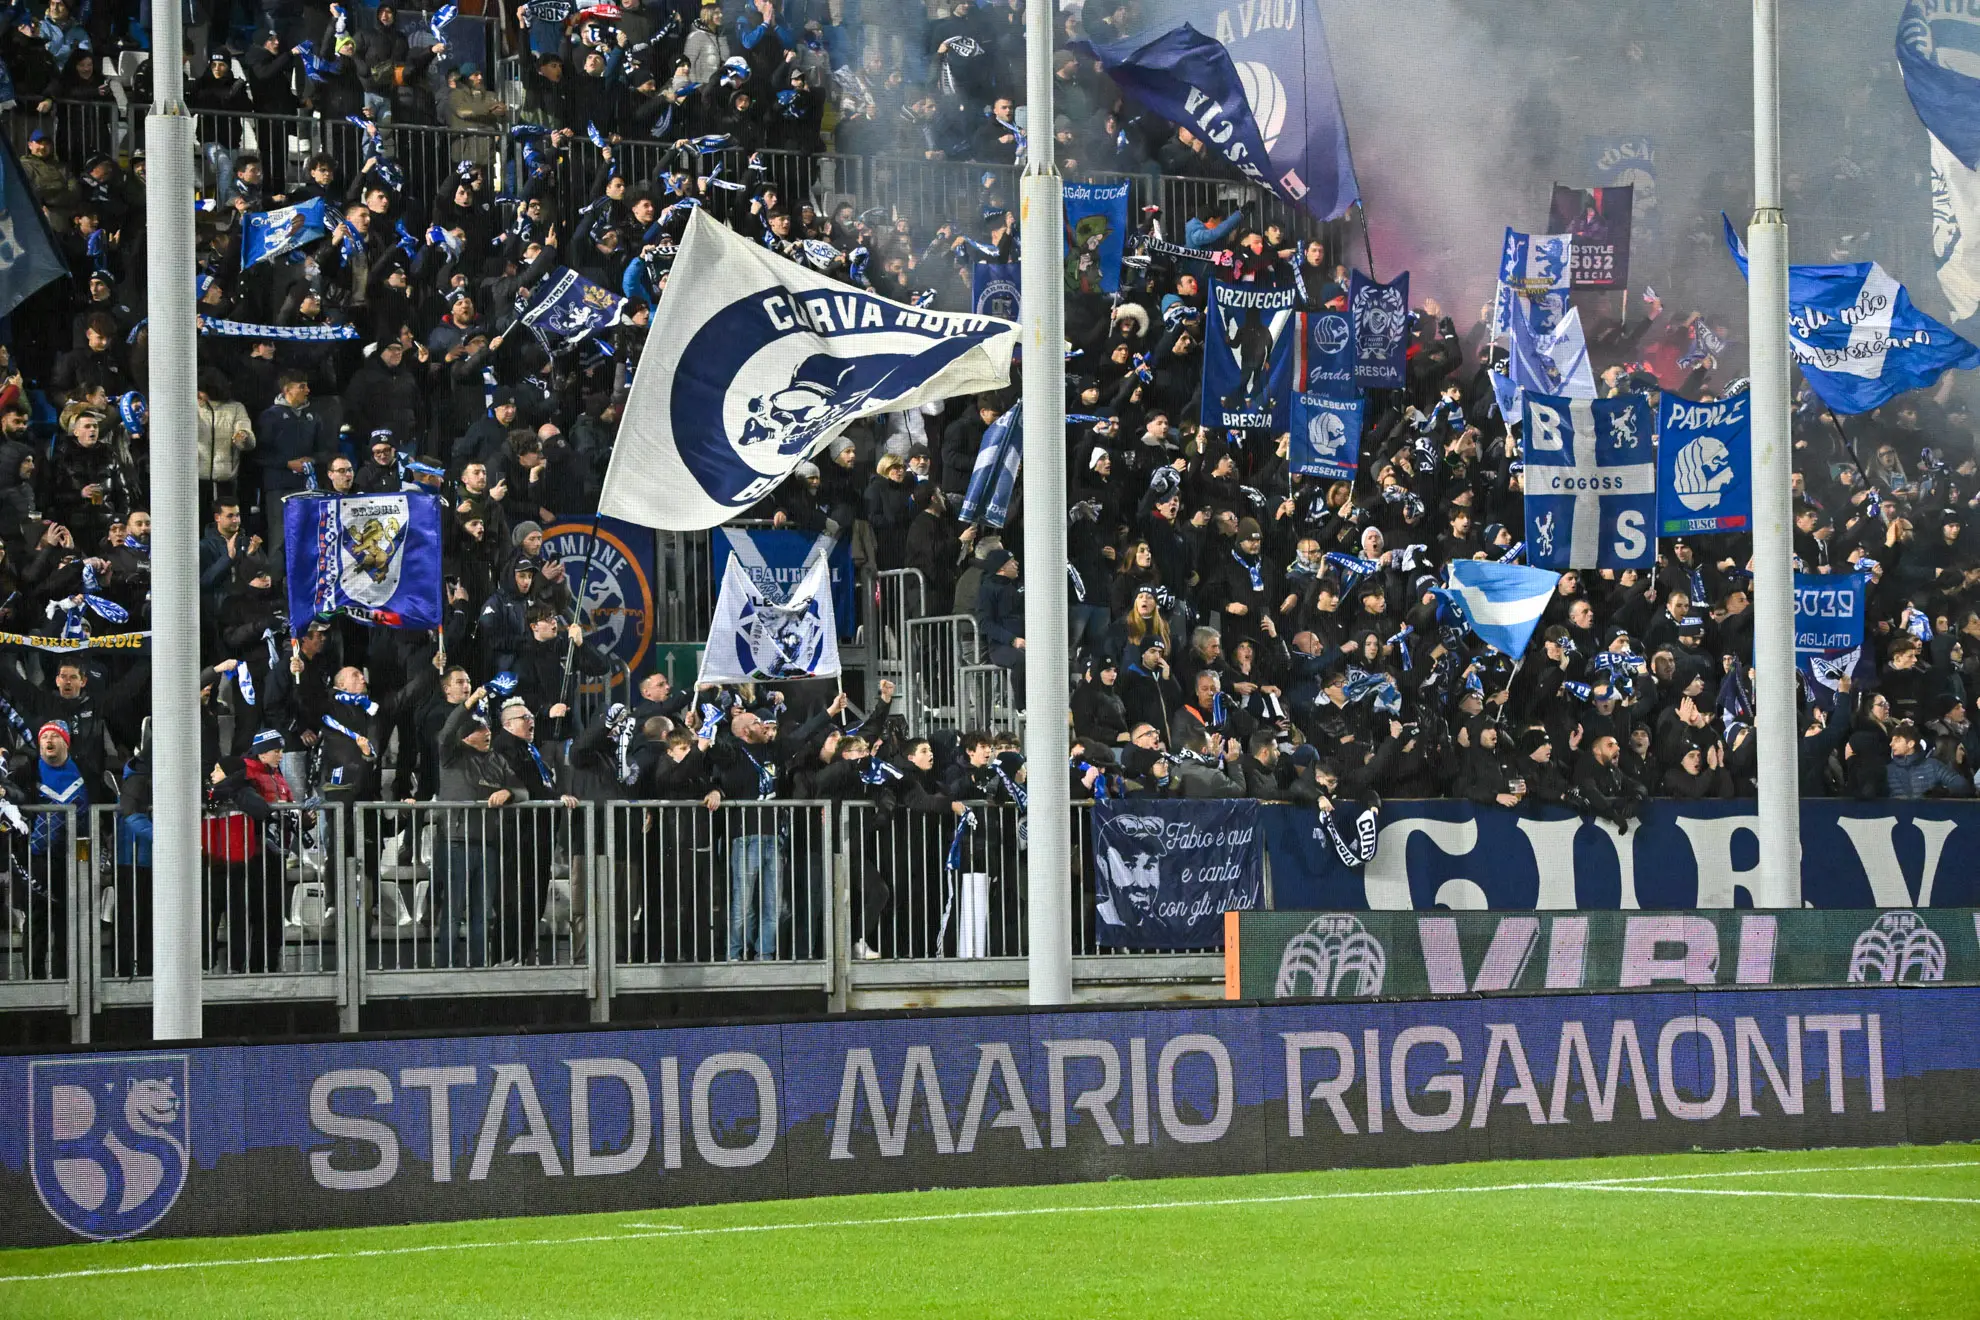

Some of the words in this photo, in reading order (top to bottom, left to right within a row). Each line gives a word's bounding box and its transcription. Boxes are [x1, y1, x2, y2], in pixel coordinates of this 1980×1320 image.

[1184, 86, 1282, 200] ESCIA
[1063, 185, 1091, 200] IGADA
[1581, 246, 1614, 254] STYLE
[1571, 272, 1613, 280] ESCIA
[1214, 286, 1295, 309] ORZIVECCHI
[1840, 291, 1887, 325] mio
[763, 295, 884, 336] CURVA
[1310, 365, 1352, 383] Garda
[1354, 364, 1398, 378] BRESCIA
[1300, 396, 1357, 412] COLLEBEATO
[1222, 412, 1273, 428] BRESCIA
[1529, 401, 1564, 451] B
[1300, 464, 1348, 479] PRESENTE
[1613, 510, 1647, 561] S
[544, 534, 628, 577] RMIONE
[88, 633, 143, 649] MEDIE
[1166, 821, 1213, 851] Fabio
[1182, 869, 1193, 884] e
[1198, 860, 1242, 884] canta
[1158, 900, 1188, 916] con
[1188, 893, 1213, 928] gli
[308, 1051, 779, 1191] STADIO
[828, 1033, 1234, 1160] MARIO
[1279, 1012, 1886, 1138] RIGAMONTI
